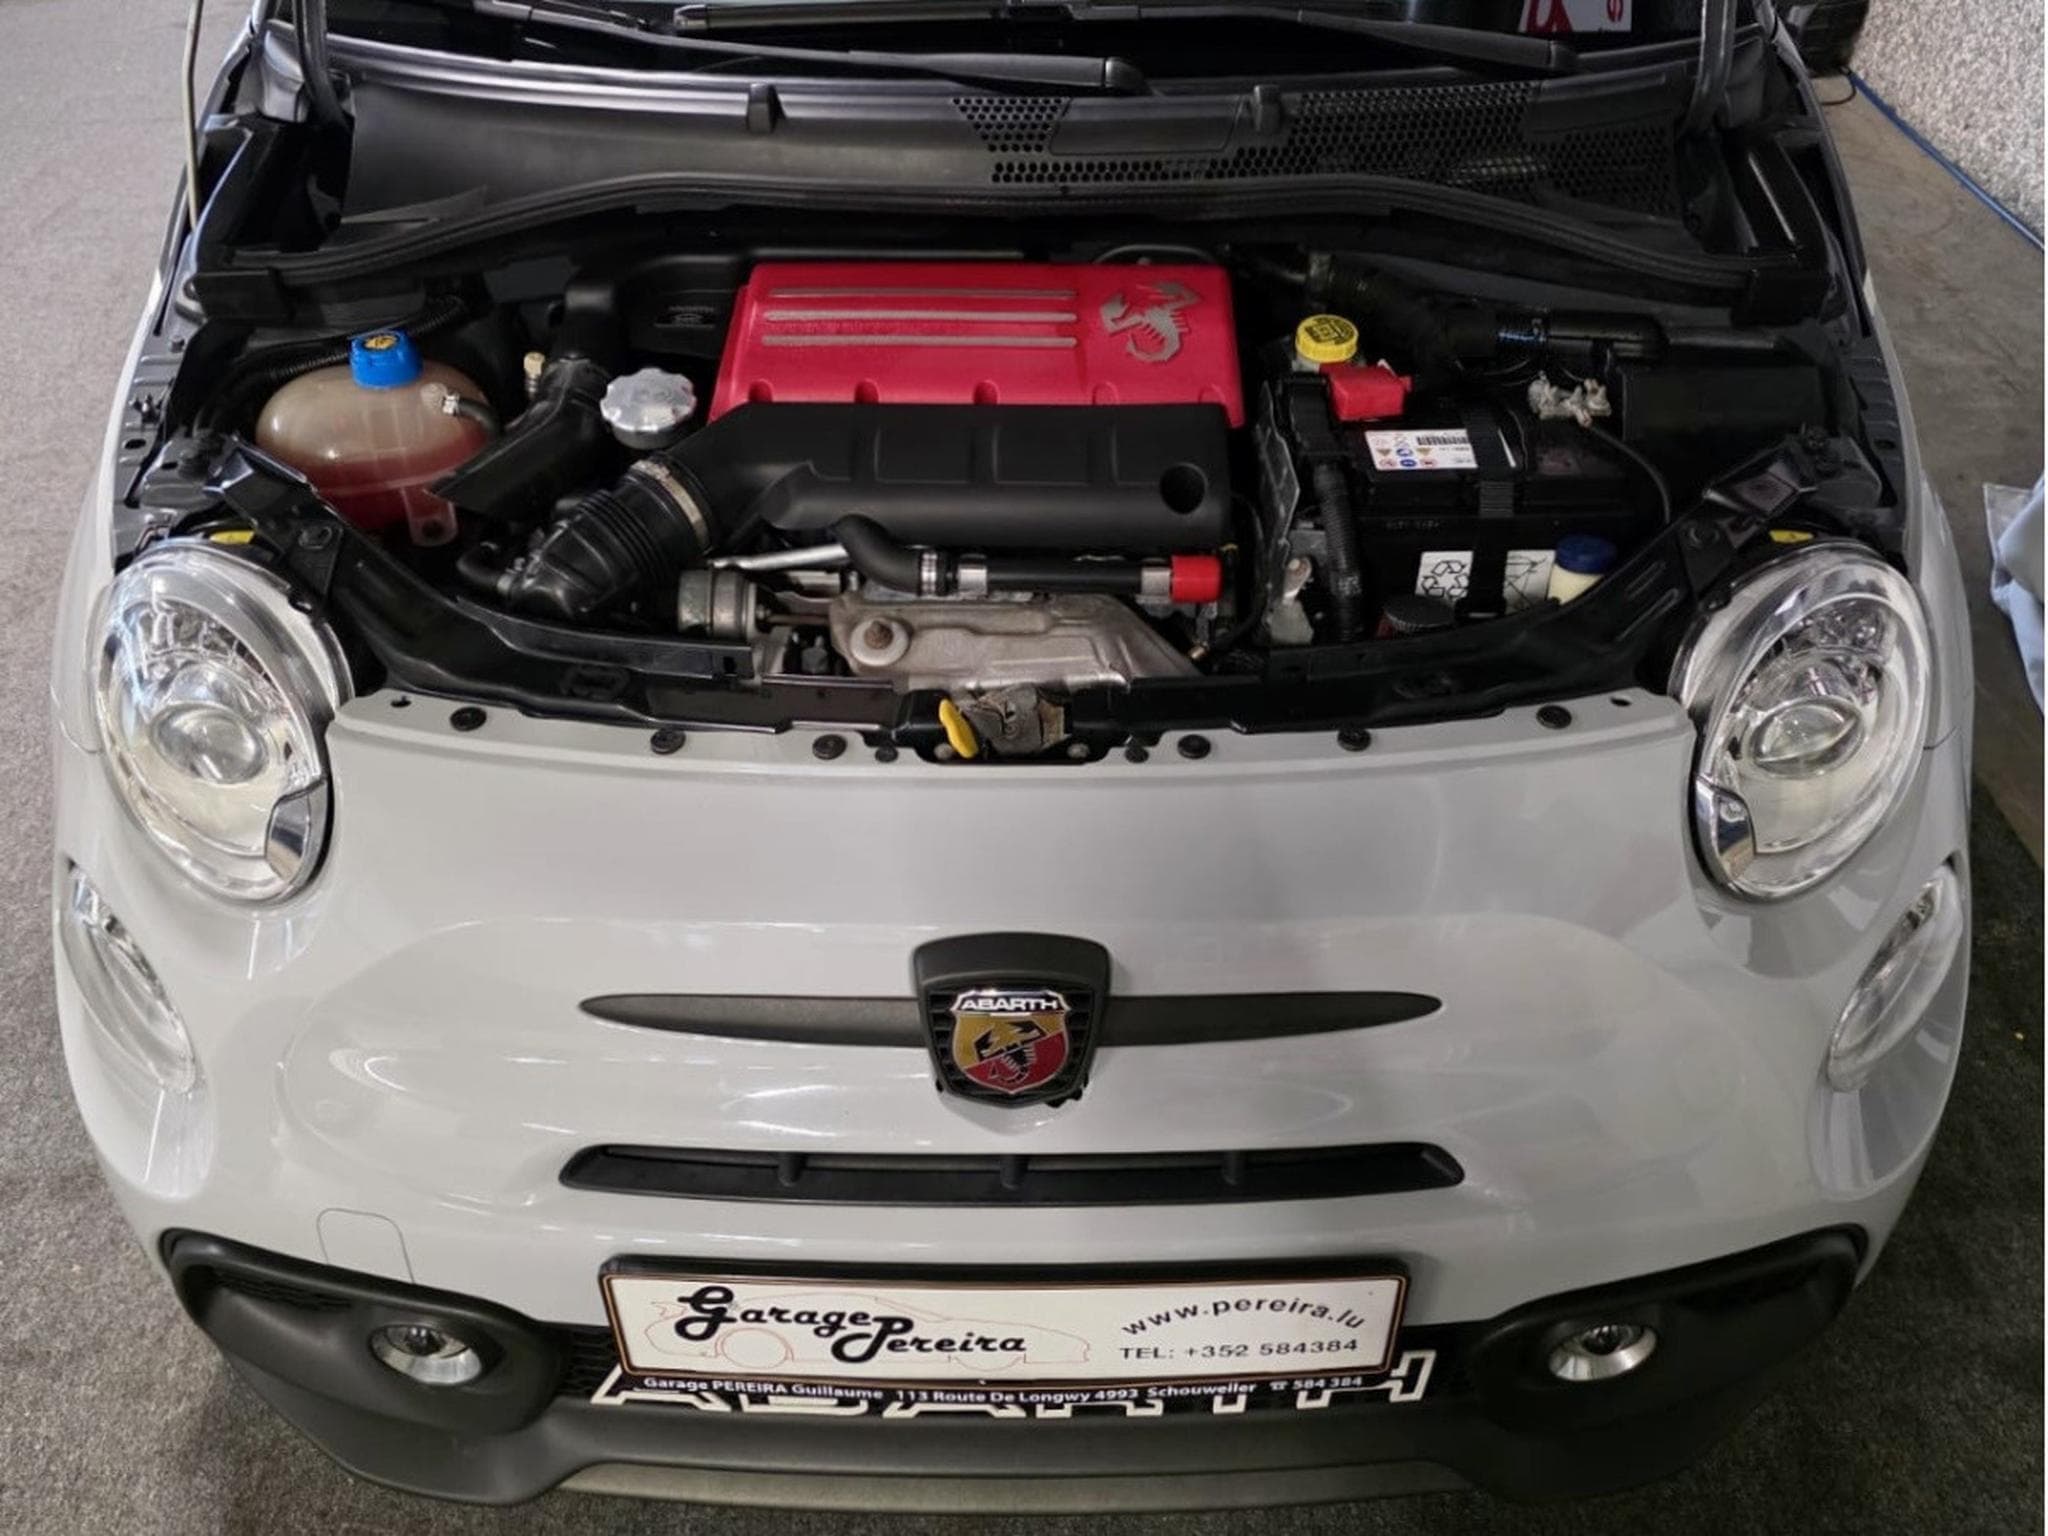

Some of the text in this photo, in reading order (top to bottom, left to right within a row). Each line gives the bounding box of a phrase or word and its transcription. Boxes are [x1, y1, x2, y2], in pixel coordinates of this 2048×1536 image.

[961, 998, 1058, 1010] ABARTH
[673, 1285, 873, 1342] Garage
[1121, 1297, 1366, 1336] www.pereira.lu
[830, 1315, 1027, 1364] Pereira
[1119, 1338, 1359, 1360] TEL: +352 584384
[643, 1376, 1363, 1405] Garage PEREIRA Guillaume 113 Route De Longwy 4993 Schouweiler 584 384
